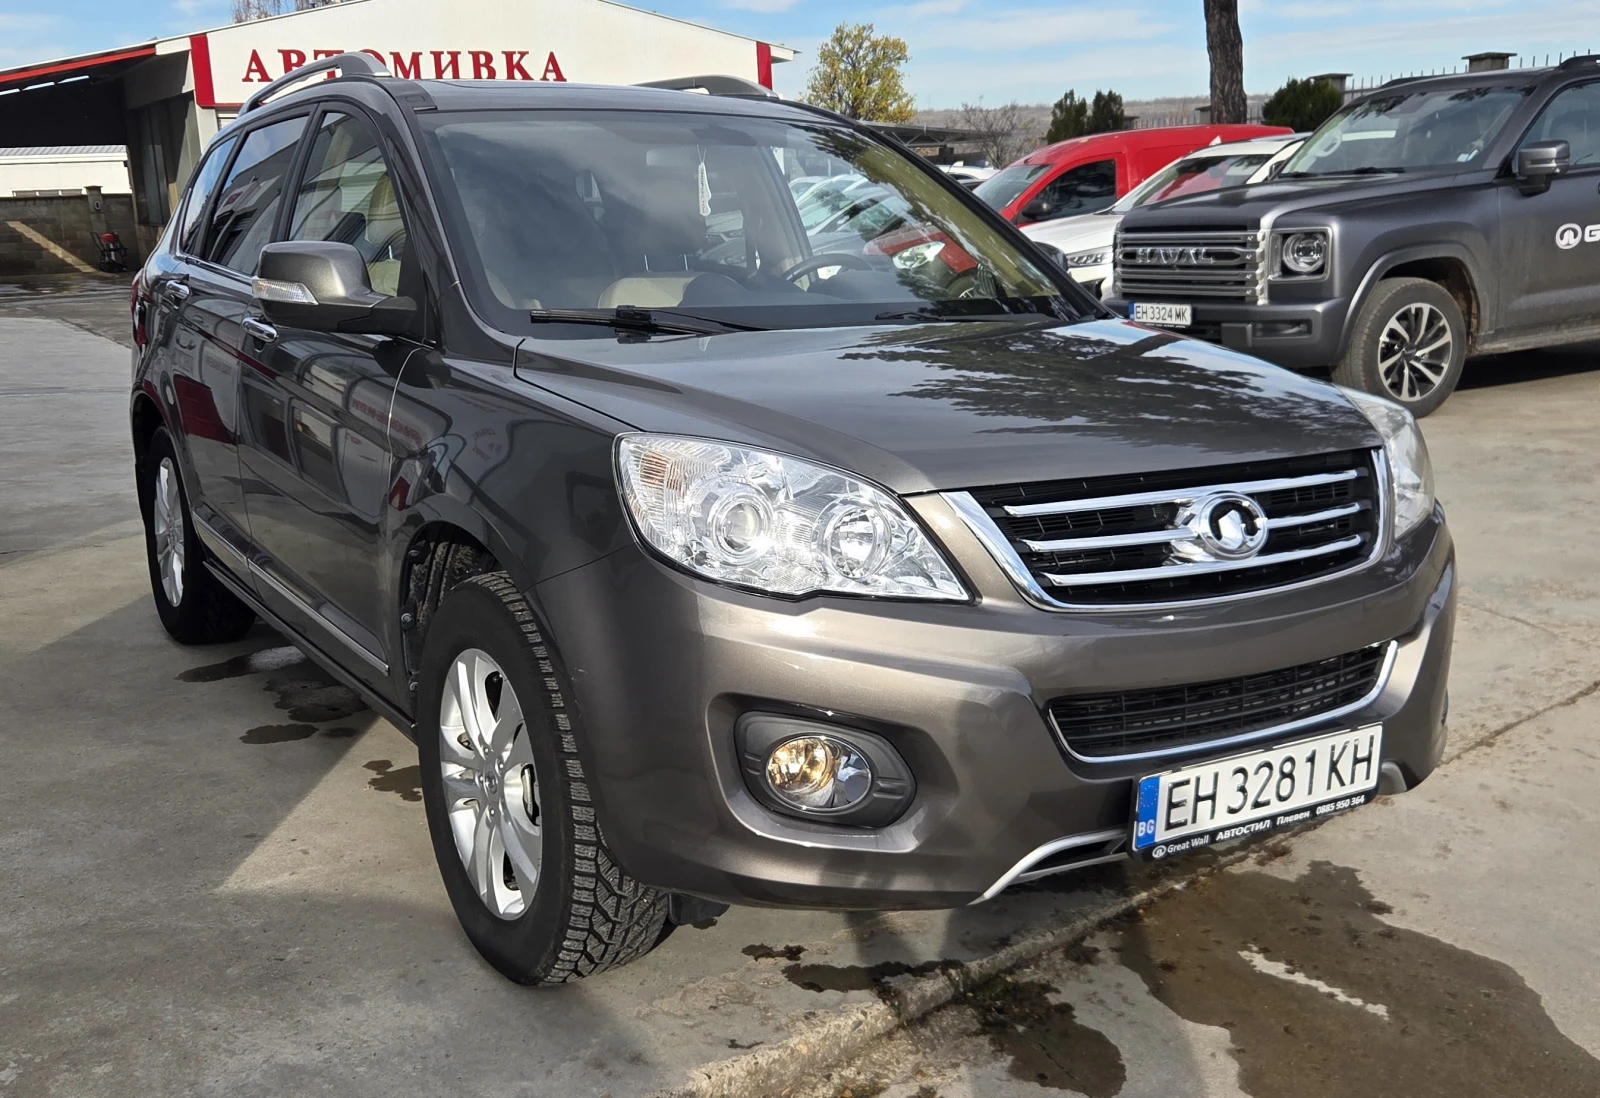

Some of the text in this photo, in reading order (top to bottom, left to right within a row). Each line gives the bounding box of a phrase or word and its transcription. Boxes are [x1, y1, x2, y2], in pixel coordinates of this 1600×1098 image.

[1149, 306, 1173, 321] 3324
[1226, 749, 1317, 815] 3281
[1137, 818, 1155, 837] BG
[1167, 794, 1366, 854] Great Wall АВТОСТИЛ Плевен 0885 950 364
